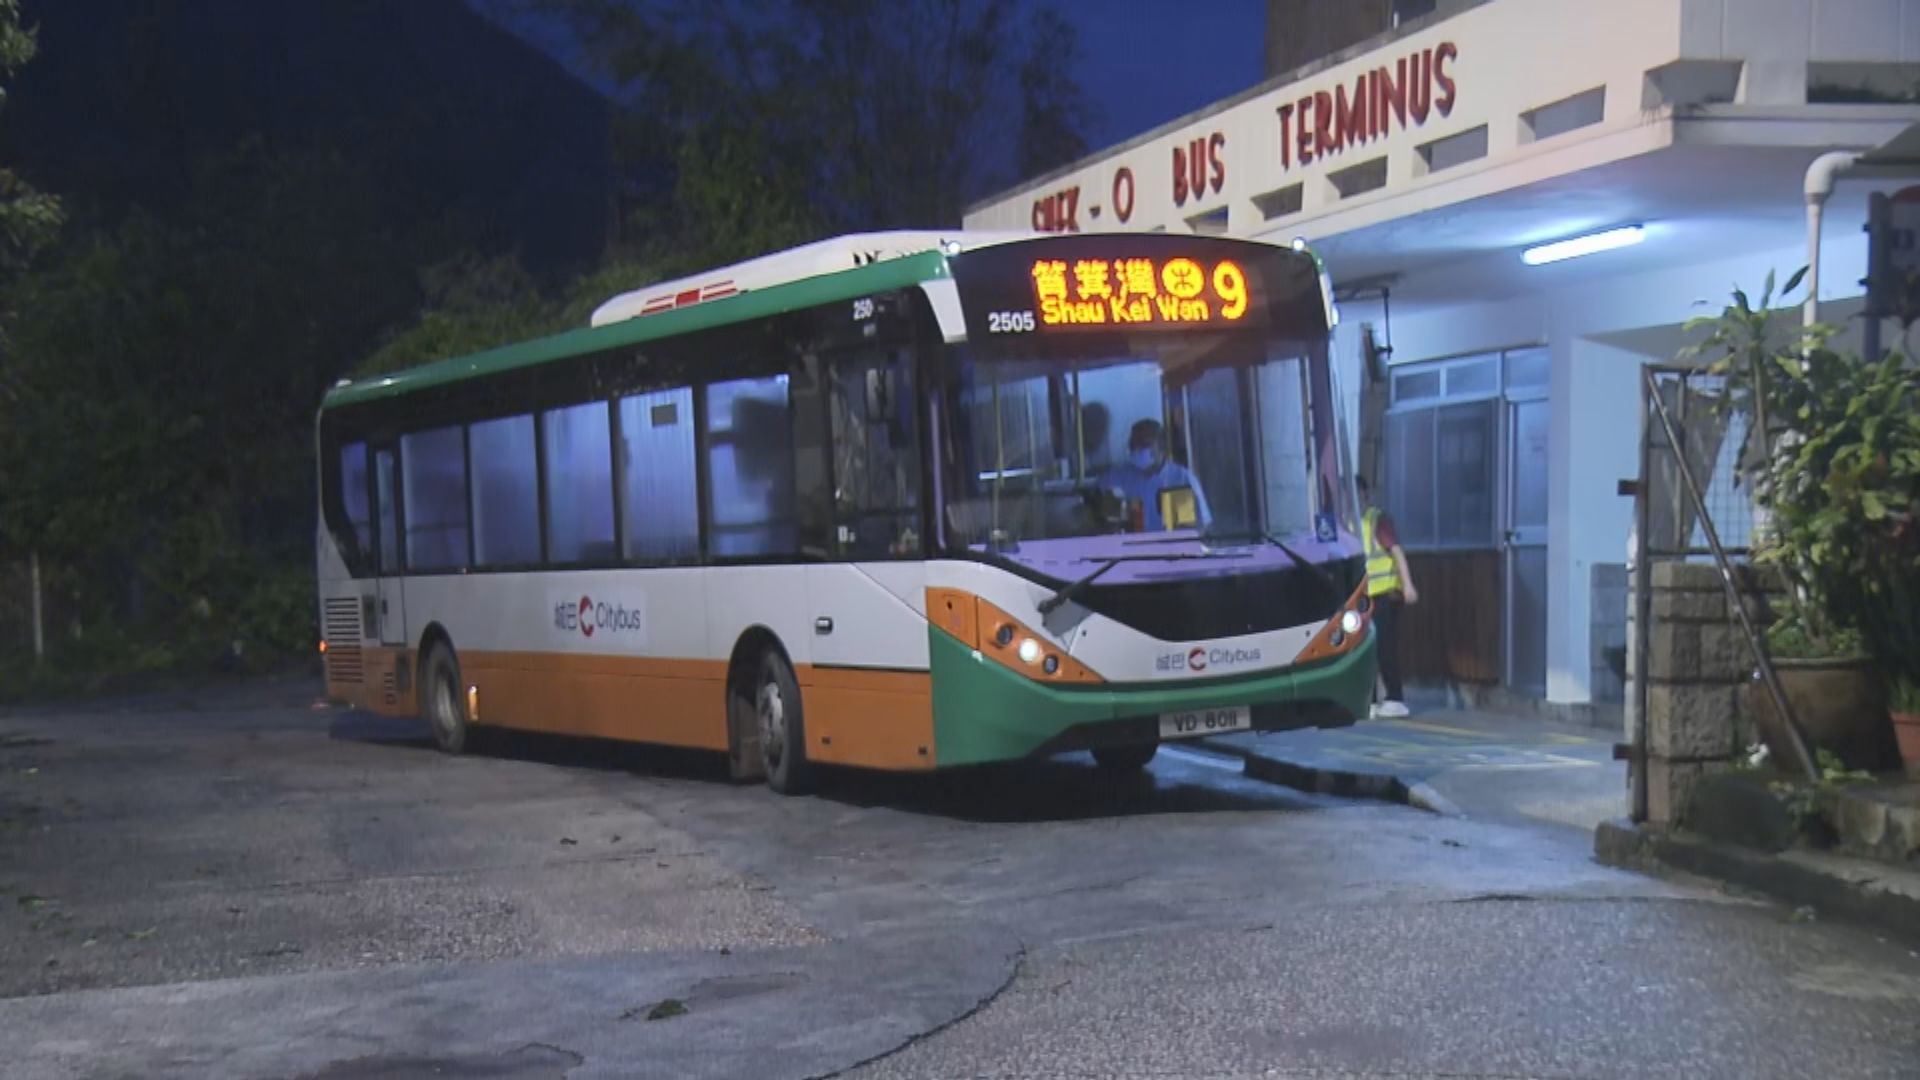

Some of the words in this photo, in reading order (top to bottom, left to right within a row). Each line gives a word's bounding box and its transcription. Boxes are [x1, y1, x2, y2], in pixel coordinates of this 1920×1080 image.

[1113, 166, 1135, 223] O
[1173, 131, 1225, 206] BUS
[1276, 41, 1457, 170] TERMINUS
[1212, 261, 1248, 320] 9
[988, 311, 1036, 332] 2505
[1041, 298, 1106, 324] Shau
[1110, 297, 1152, 322] Kei
[1156, 295, 1208, 321] Wan
[596, 602, 641, 632] Citybus
[1209, 648, 1262, 664] Citybus
